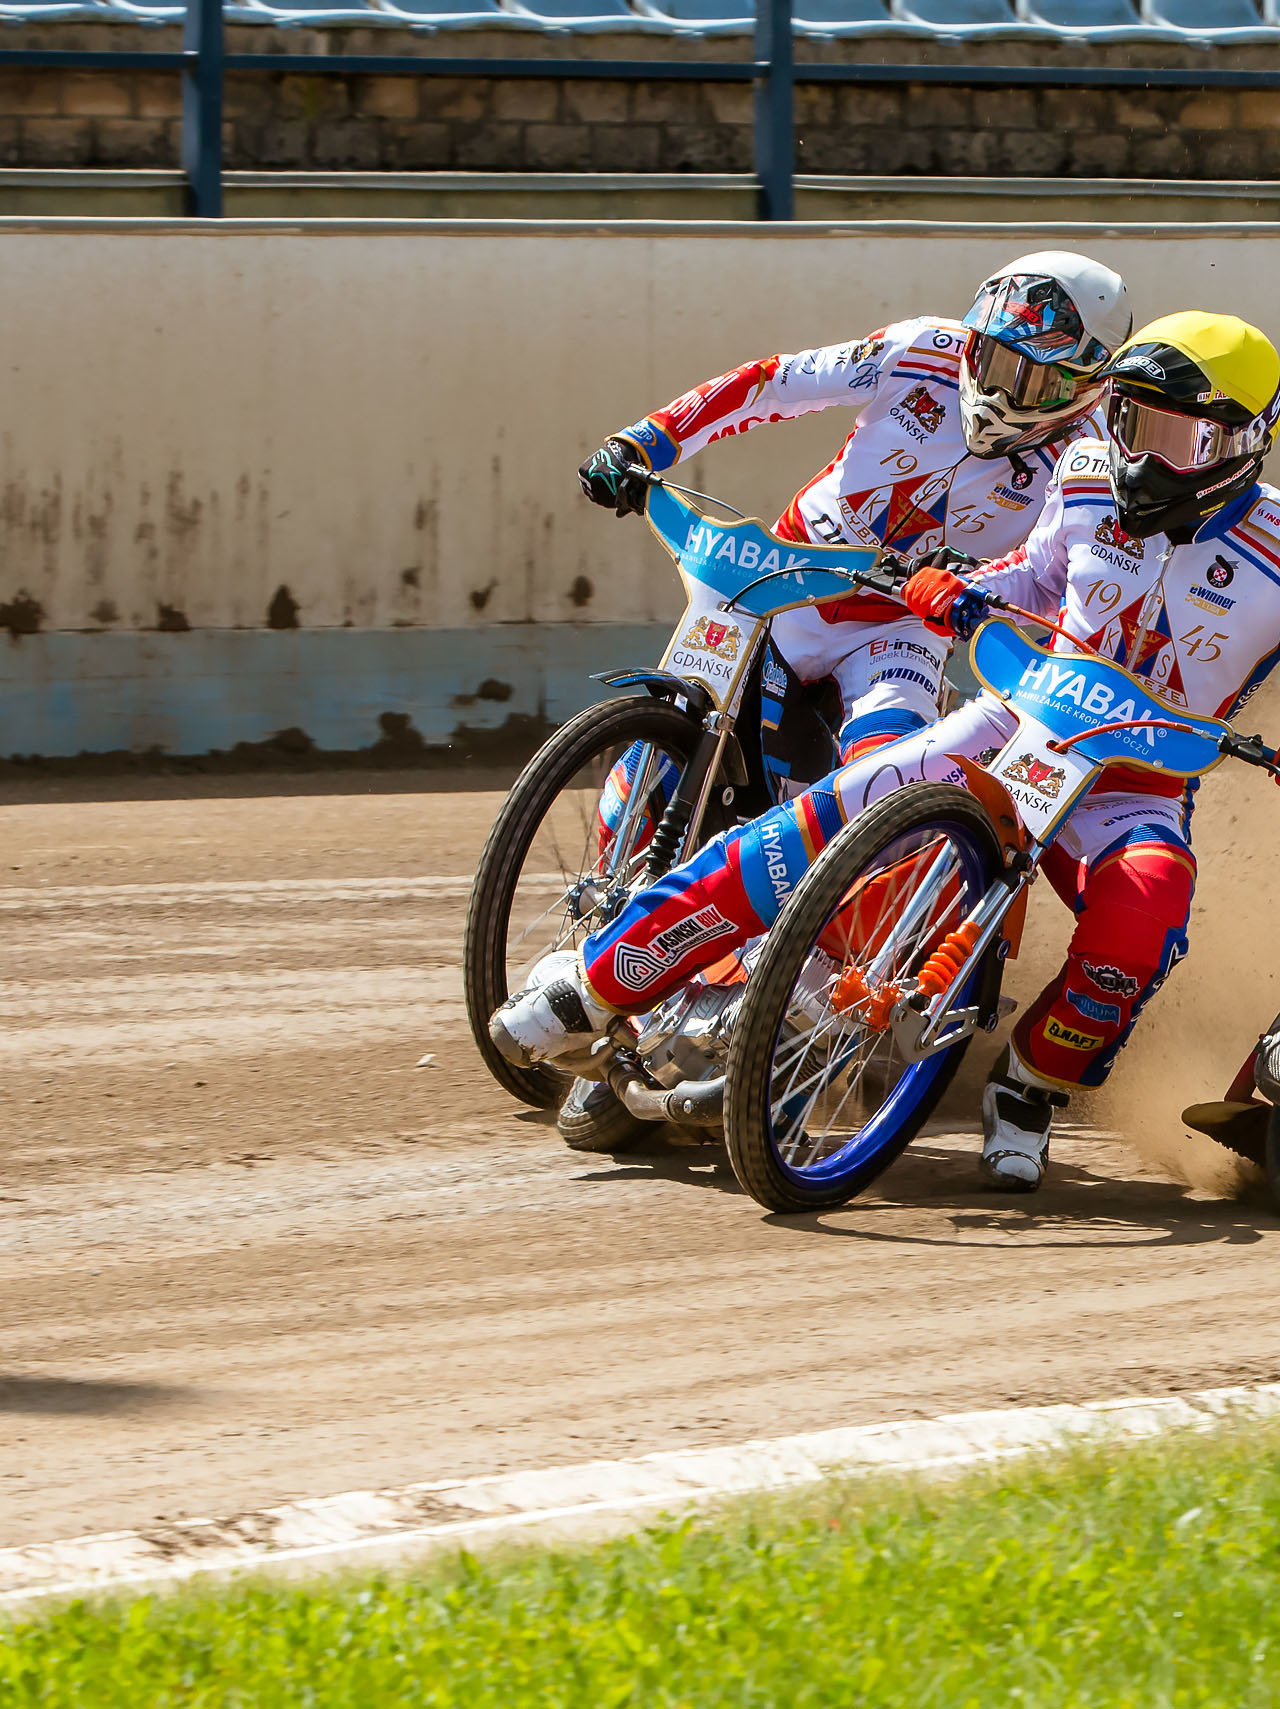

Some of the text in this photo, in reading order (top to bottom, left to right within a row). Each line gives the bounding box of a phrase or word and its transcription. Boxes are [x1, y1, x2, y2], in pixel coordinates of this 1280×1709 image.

[880, 448, 919, 476] 19
[861, 493, 887, 522] K
[951, 504, 996, 534] 45
[684, 524, 812, 585] HYABAK
[915, 535, 937, 556] S
[1090, 544, 1142, 577] GDAŃSK
[1084, 579, 1122, 615] 19
[1189, 586, 1237, 611] eWinner
[1102, 627, 1121, 655] K
[1178, 625, 1230, 662] 45
[672, 651, 734, 681] GDAŃSK
[1156, 654, 1172, 679] S
[868, 667, 938, 698] eWinner
[1015, 689, 1073, 715] NAWILŻAJĄCE
[1072, 709, 1107, 735] KROPL
[1122, 735, 1150, 756] OCZU
[1003, 781, 1053, 814] DAŃSK
[650, 918, 705, 960] JASINSKI
